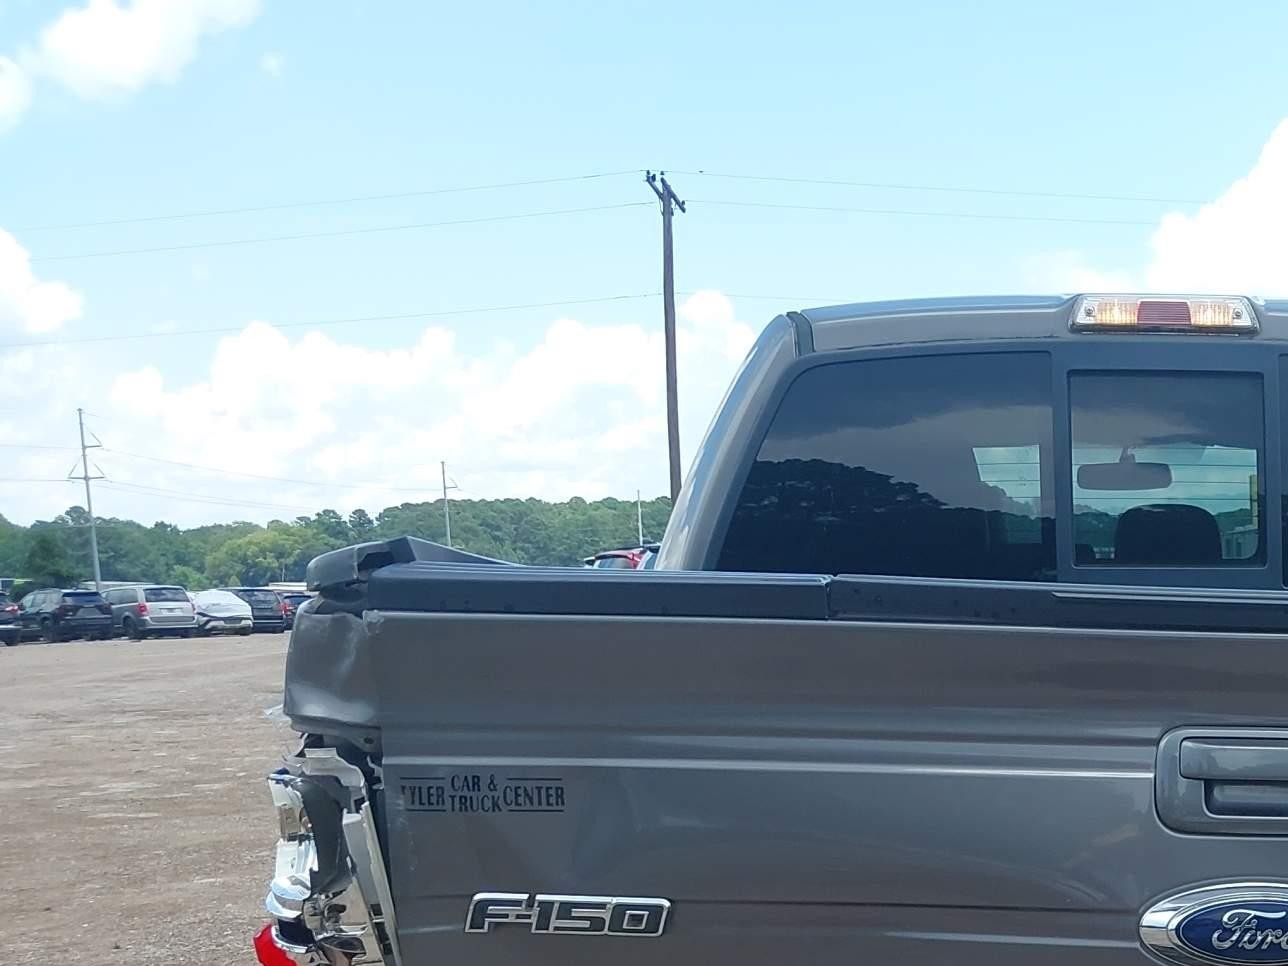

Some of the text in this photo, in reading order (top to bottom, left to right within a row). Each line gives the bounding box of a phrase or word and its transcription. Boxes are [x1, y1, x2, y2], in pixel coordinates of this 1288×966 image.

[451, 774, 498, 792] CAR &
[449, 795, 502, 812] TRUCK
[503, 785, 565, 807] CENTER
[464, 892, 672, 936] F-150
